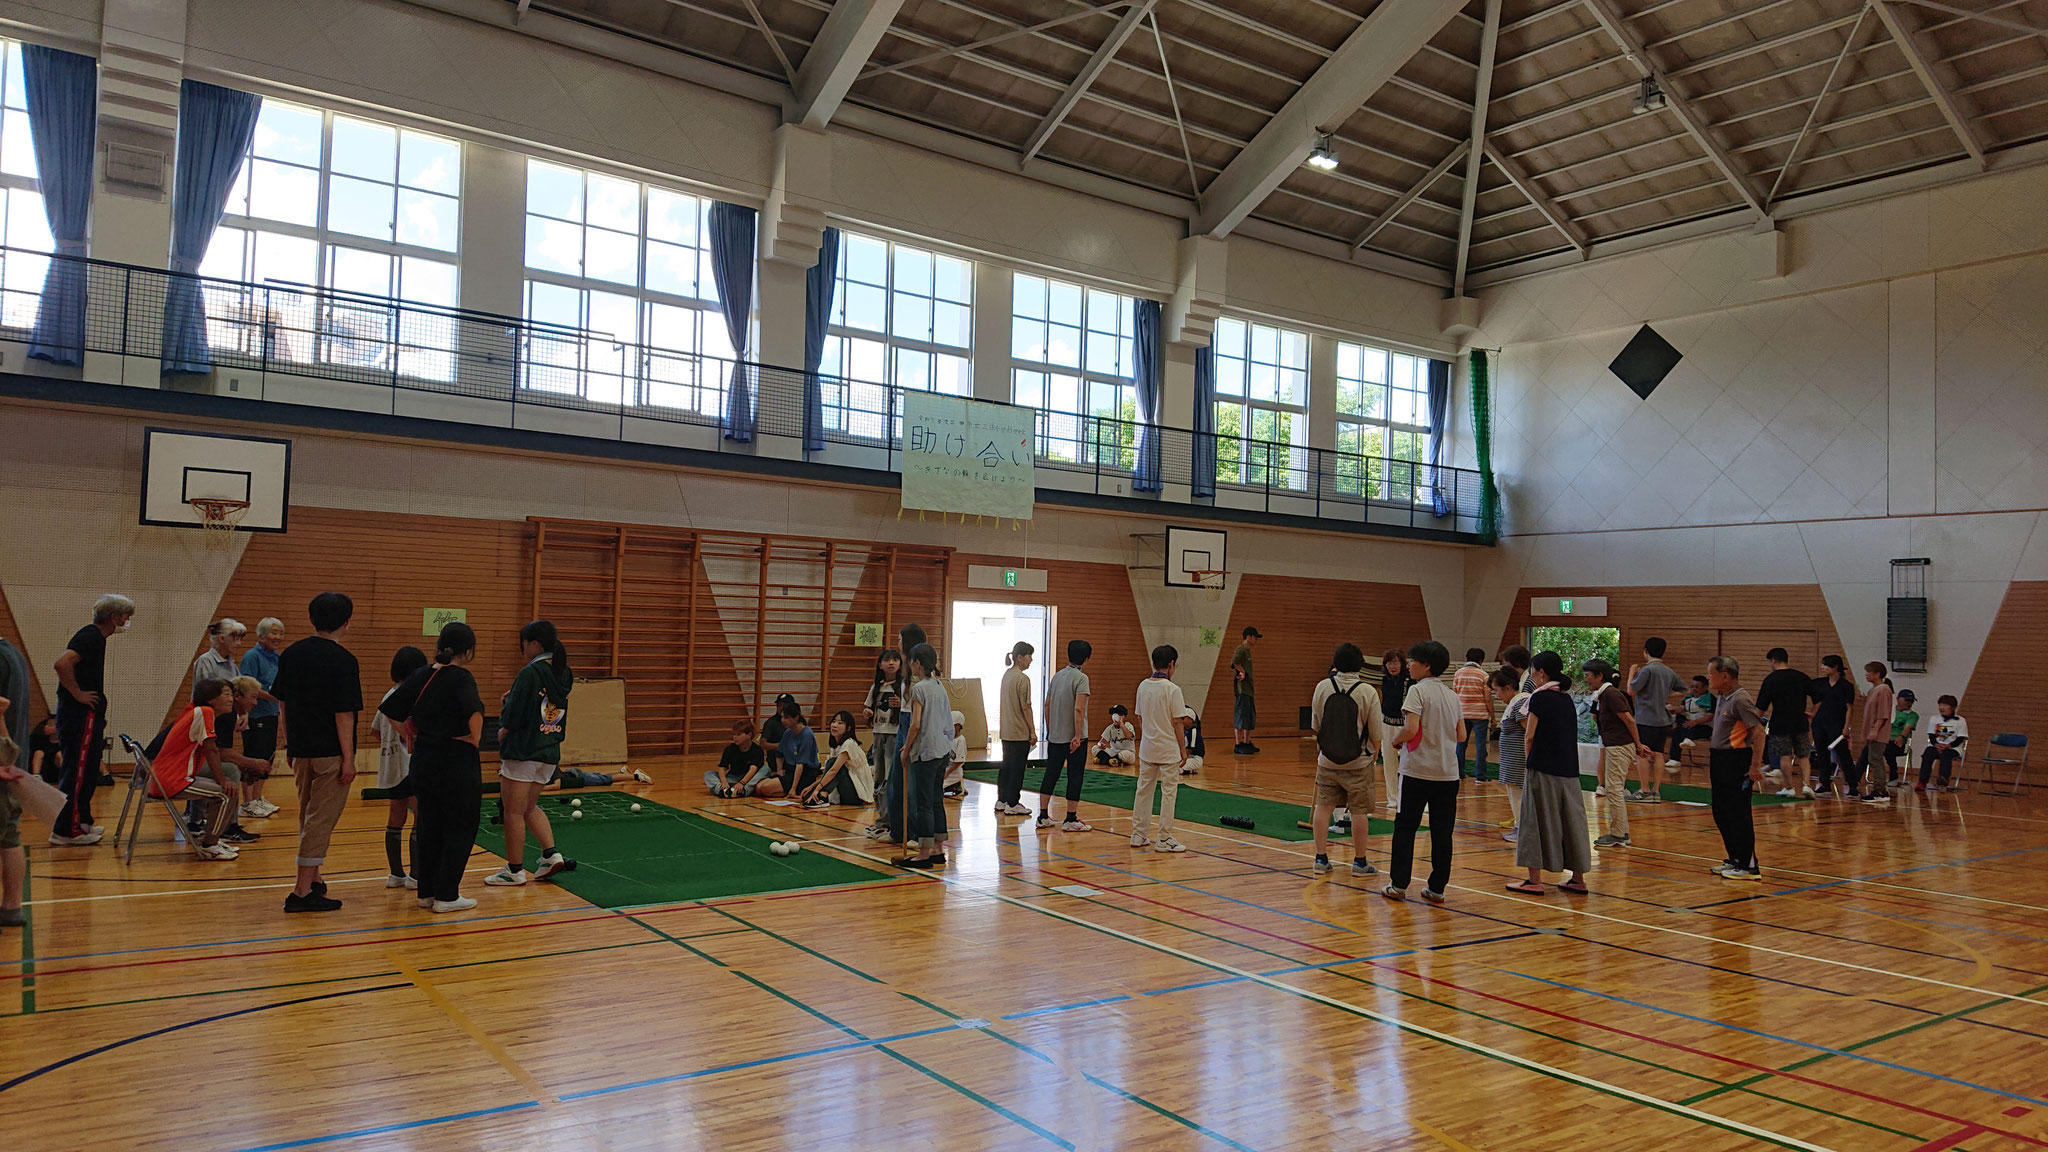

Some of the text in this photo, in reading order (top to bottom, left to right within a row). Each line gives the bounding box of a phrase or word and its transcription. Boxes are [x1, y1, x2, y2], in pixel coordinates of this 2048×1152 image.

[911, 425, 1030, 468] 助け合い
[1384, 715, 1405, 725] SYMPAT
